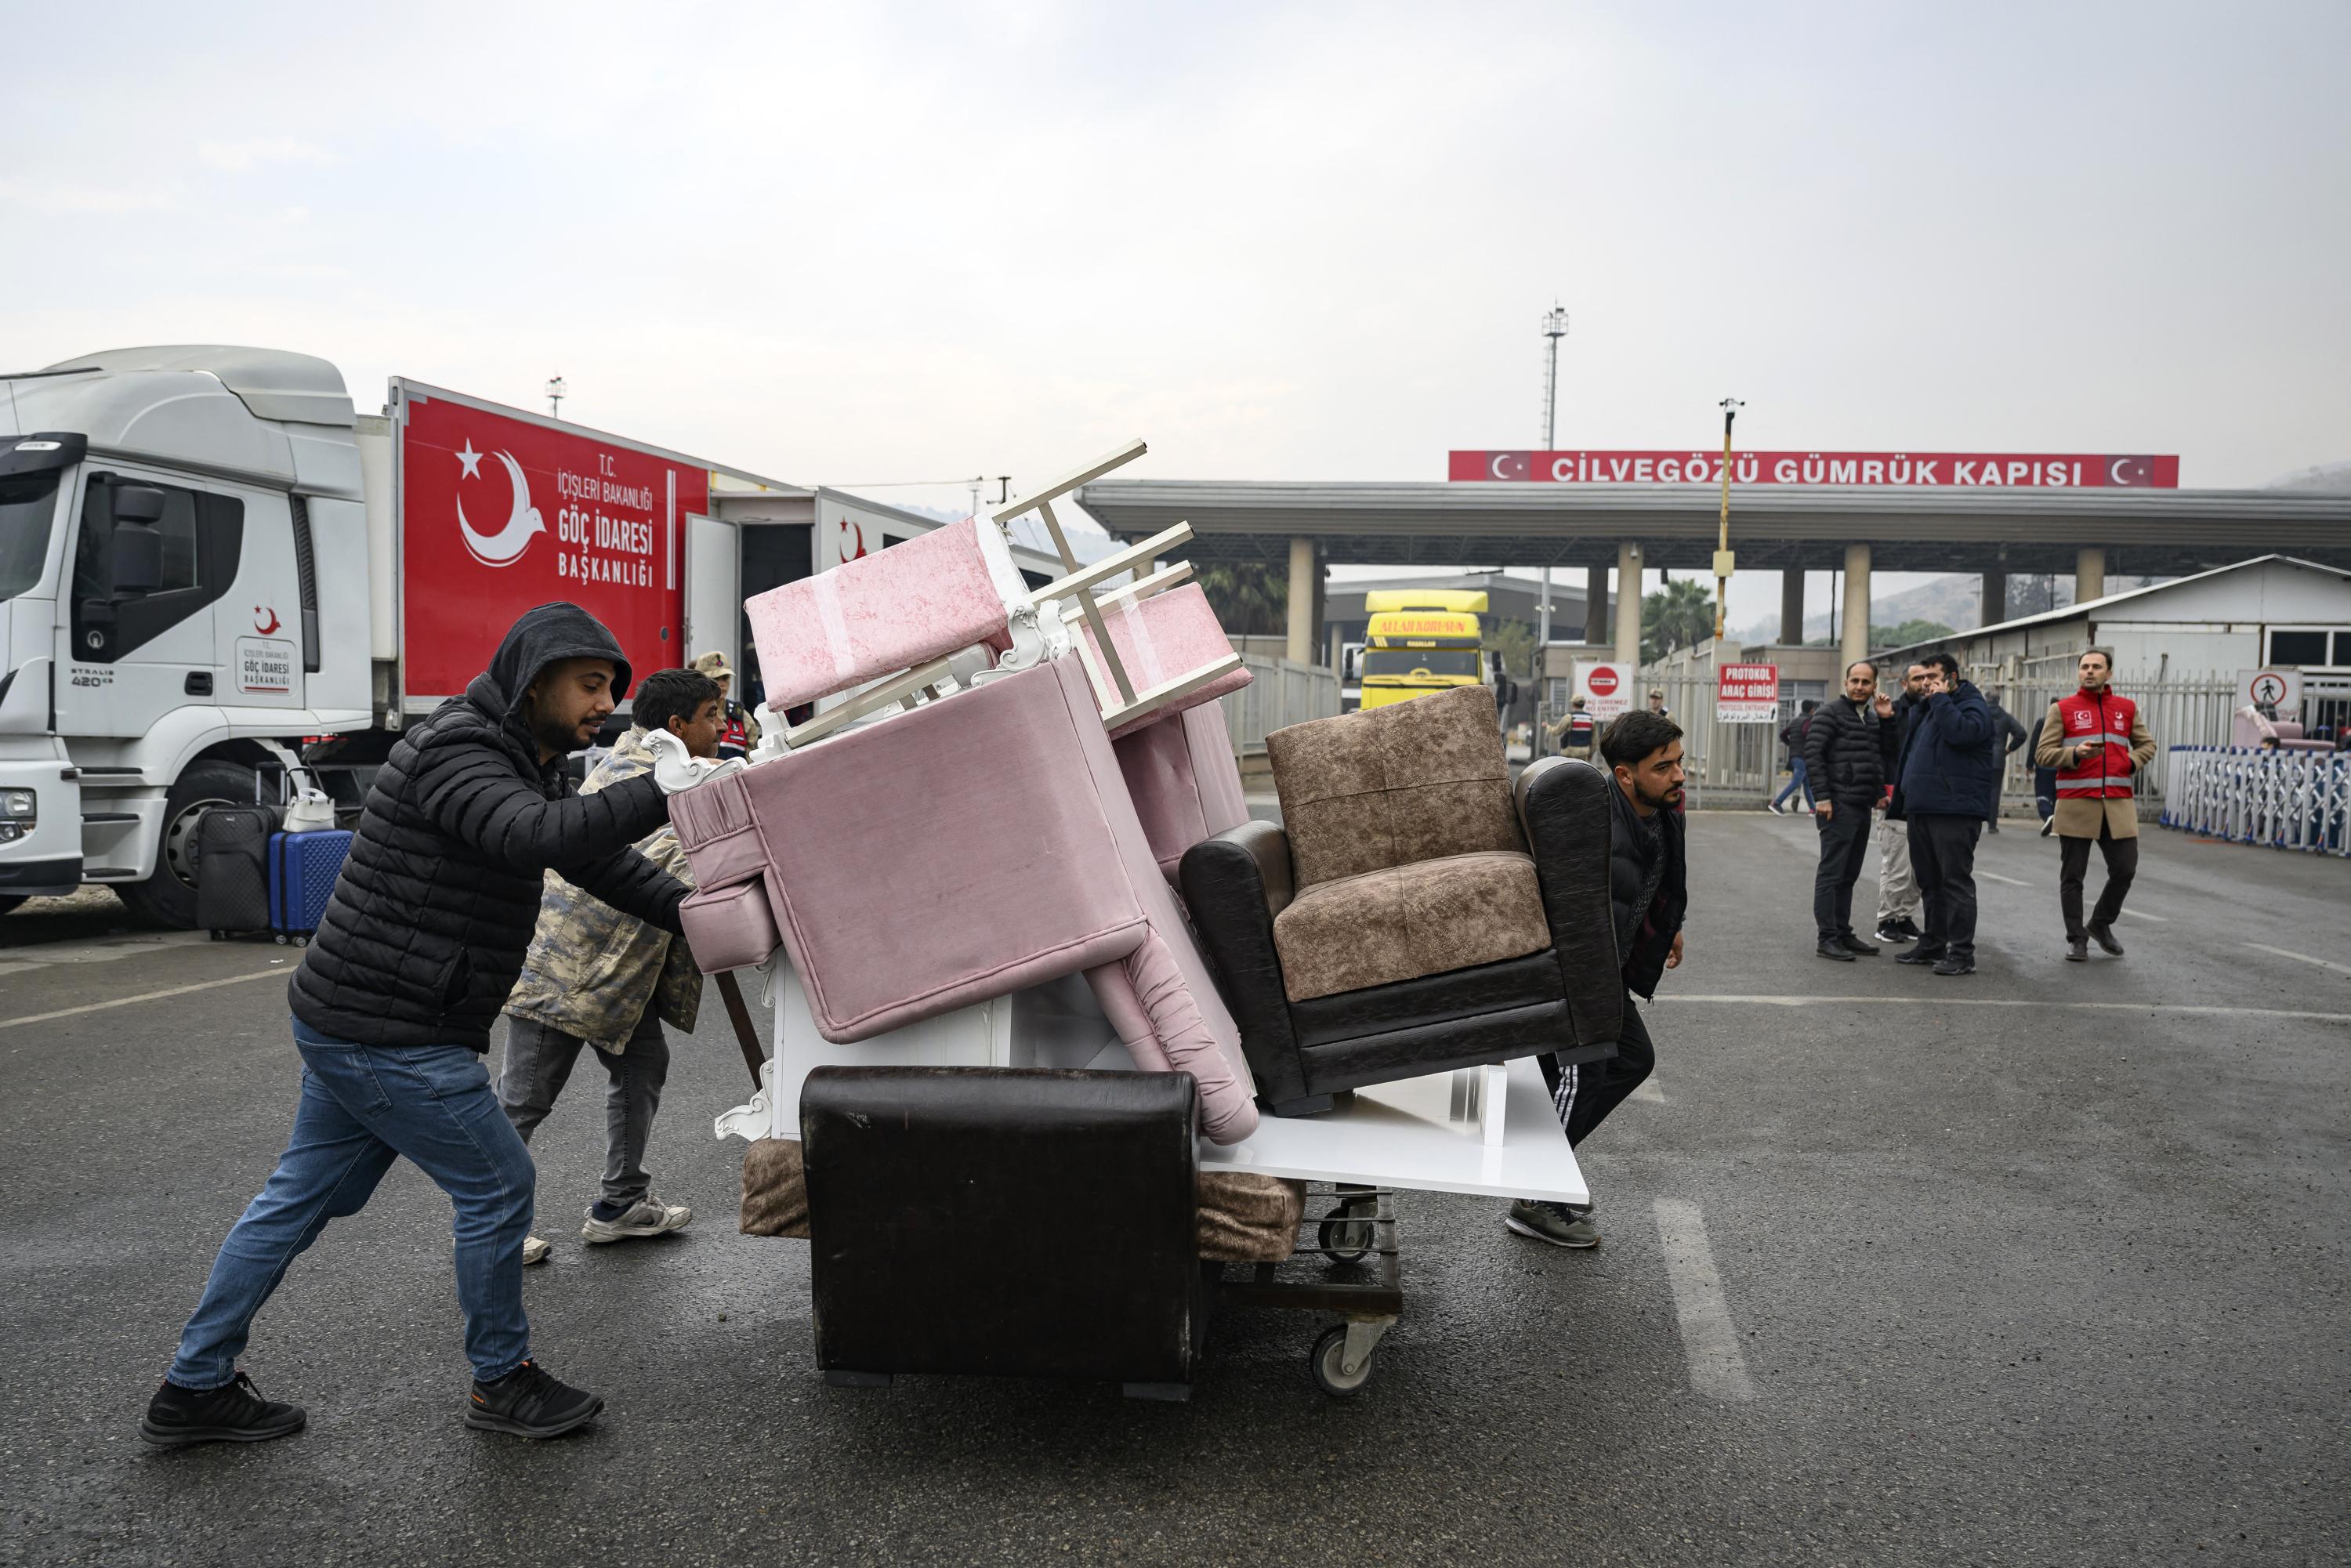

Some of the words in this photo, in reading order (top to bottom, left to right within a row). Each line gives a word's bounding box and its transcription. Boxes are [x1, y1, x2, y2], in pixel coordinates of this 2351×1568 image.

[599, 453, 617, 477] T.C.
[1552, 452, 1759, 483] CİLVEGÖZÜ
[1773, 453, 1939, 483] GÜMRÜK
[1954, 461, 2081, 487] KAPISI
[558, 468, 600, 502] İÇİŞLERİ
[603, 481, 652, 512] BAKANLIĞI
[558, 504, 590, 554] GÖÇ
[596, 509, 653, 556] İDARESİ
[558, 552, 653, 588] BAŞKANLIĞI
[1379, 621, 1414, 633] ALLAH
[245, 660, 259, 675] GÖÇ
[262, 660, 289, 674] İDARESİ
[1726, 668, 1770, 680] PROTOKOL
[245, 674, 289, 686] BAŞKANLIĞI
[1721, 684, 1745, 698] ARAÇ
[1748, 682, 1775, 699] GİRİŞİ
